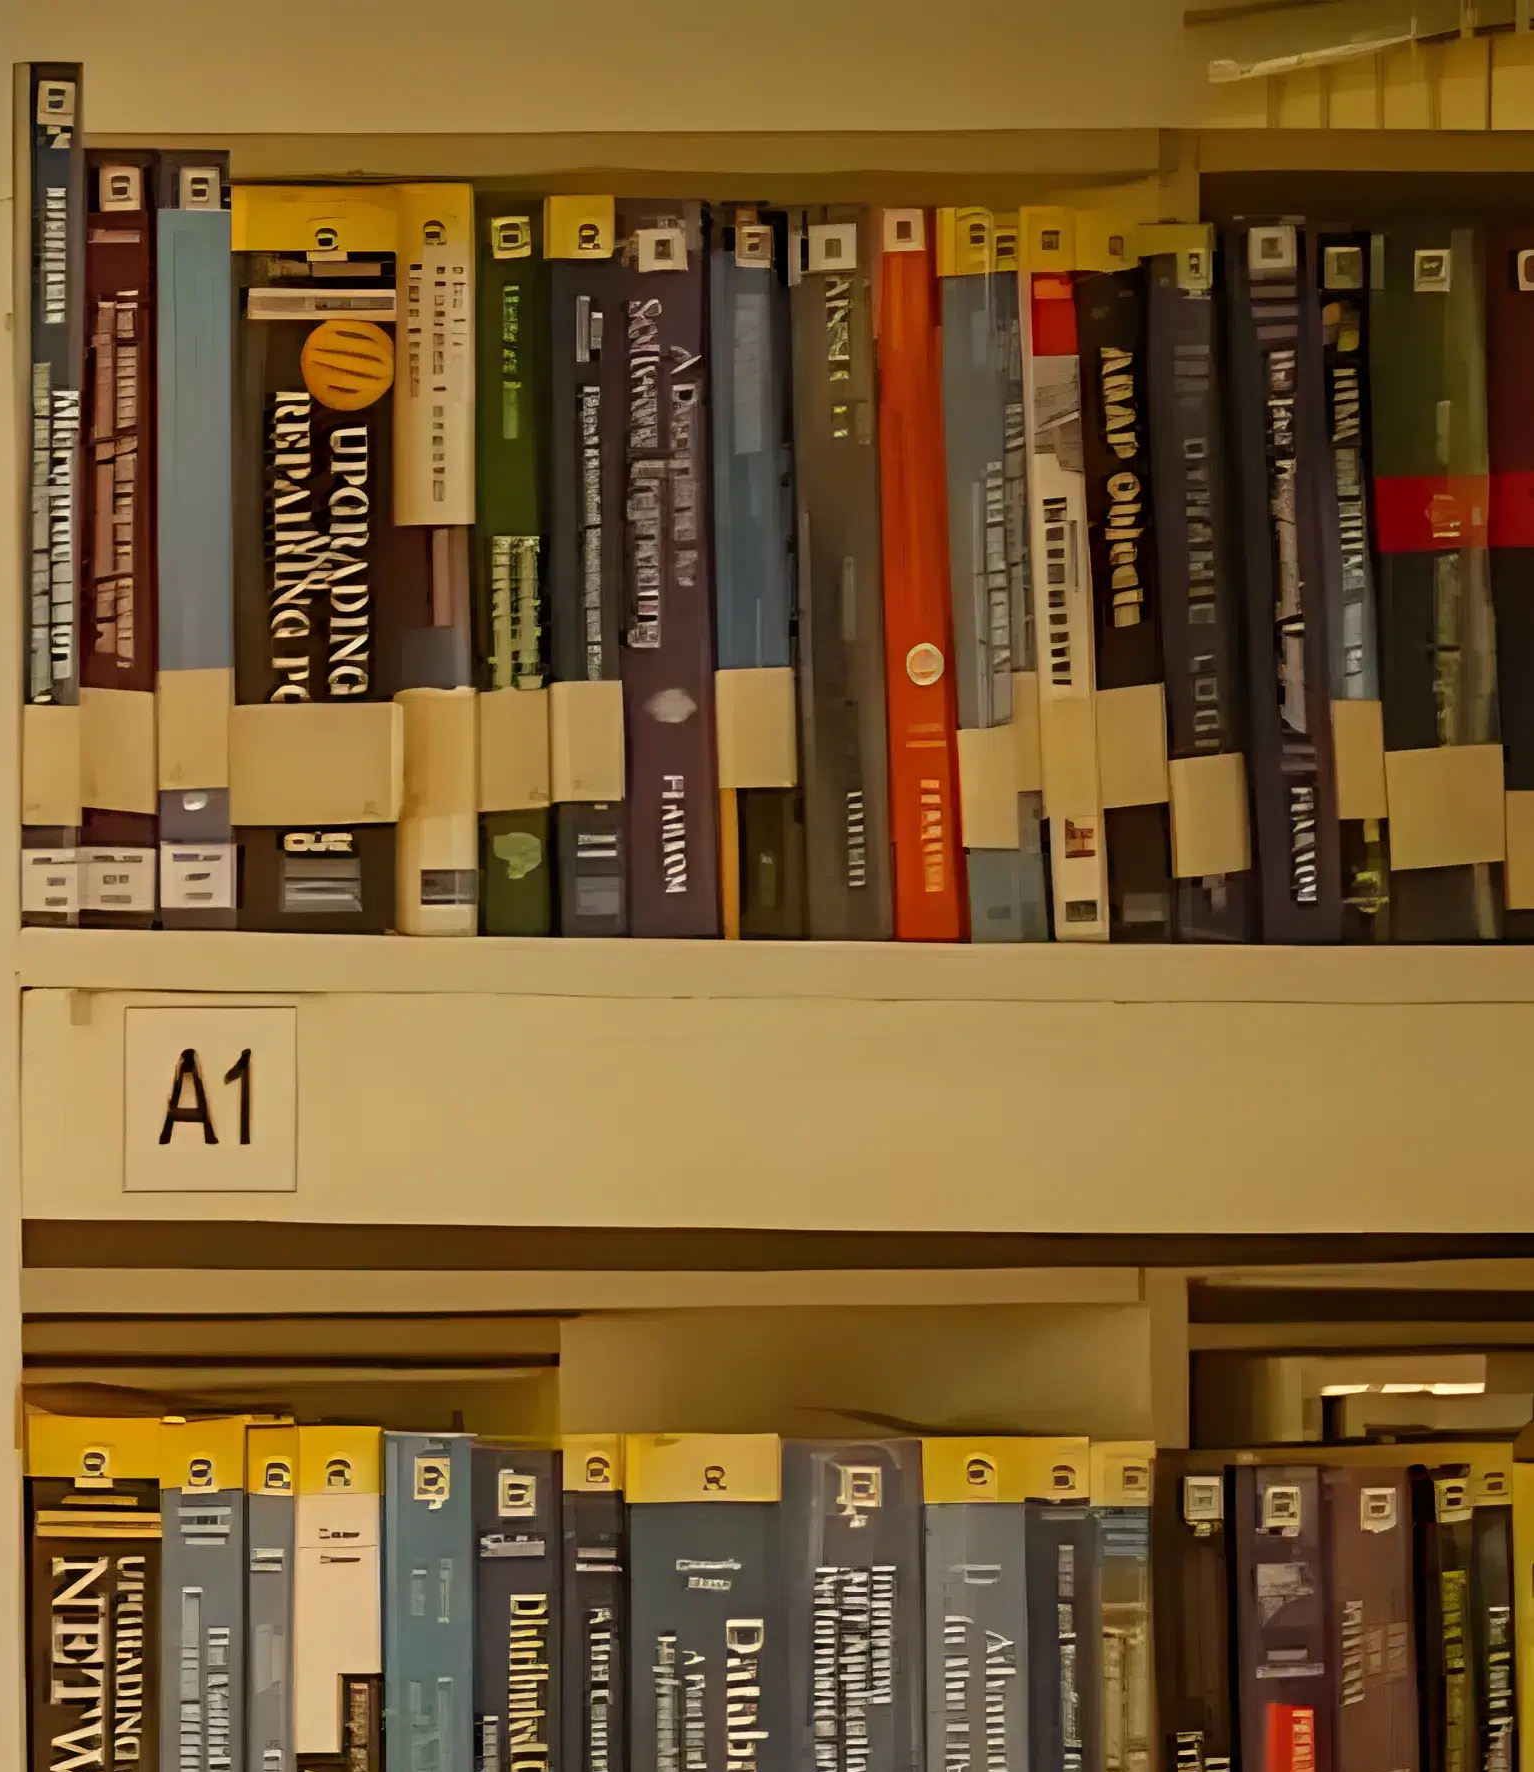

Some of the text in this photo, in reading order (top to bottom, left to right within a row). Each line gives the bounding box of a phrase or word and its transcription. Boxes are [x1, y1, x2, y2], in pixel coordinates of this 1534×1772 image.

[271, 391, 312, 639] REPAIRING
[328, 426, 370, 696] UPGRADING
[158, 1048, 253, 1145] A1
